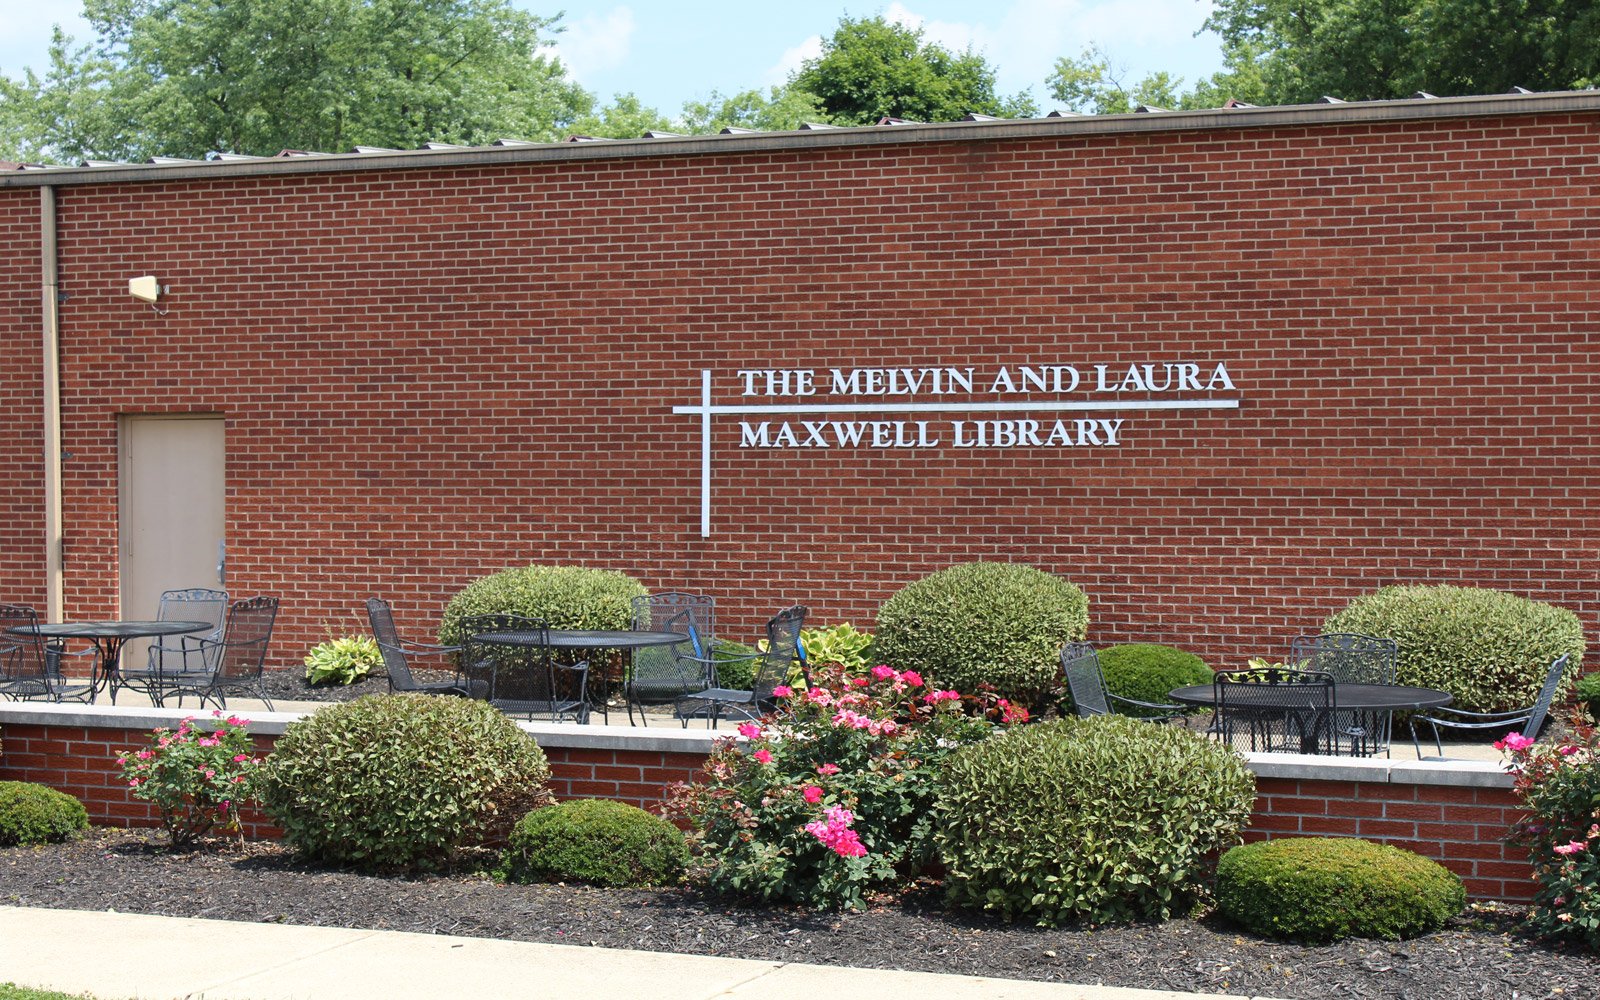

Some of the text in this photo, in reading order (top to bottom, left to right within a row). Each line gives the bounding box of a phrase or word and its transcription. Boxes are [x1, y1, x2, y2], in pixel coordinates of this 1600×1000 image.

[737, 362, 1236, 396] THE MELVIN AND LAURA
[738, 418, 1126, 448] MAXWELL LIBRARY
